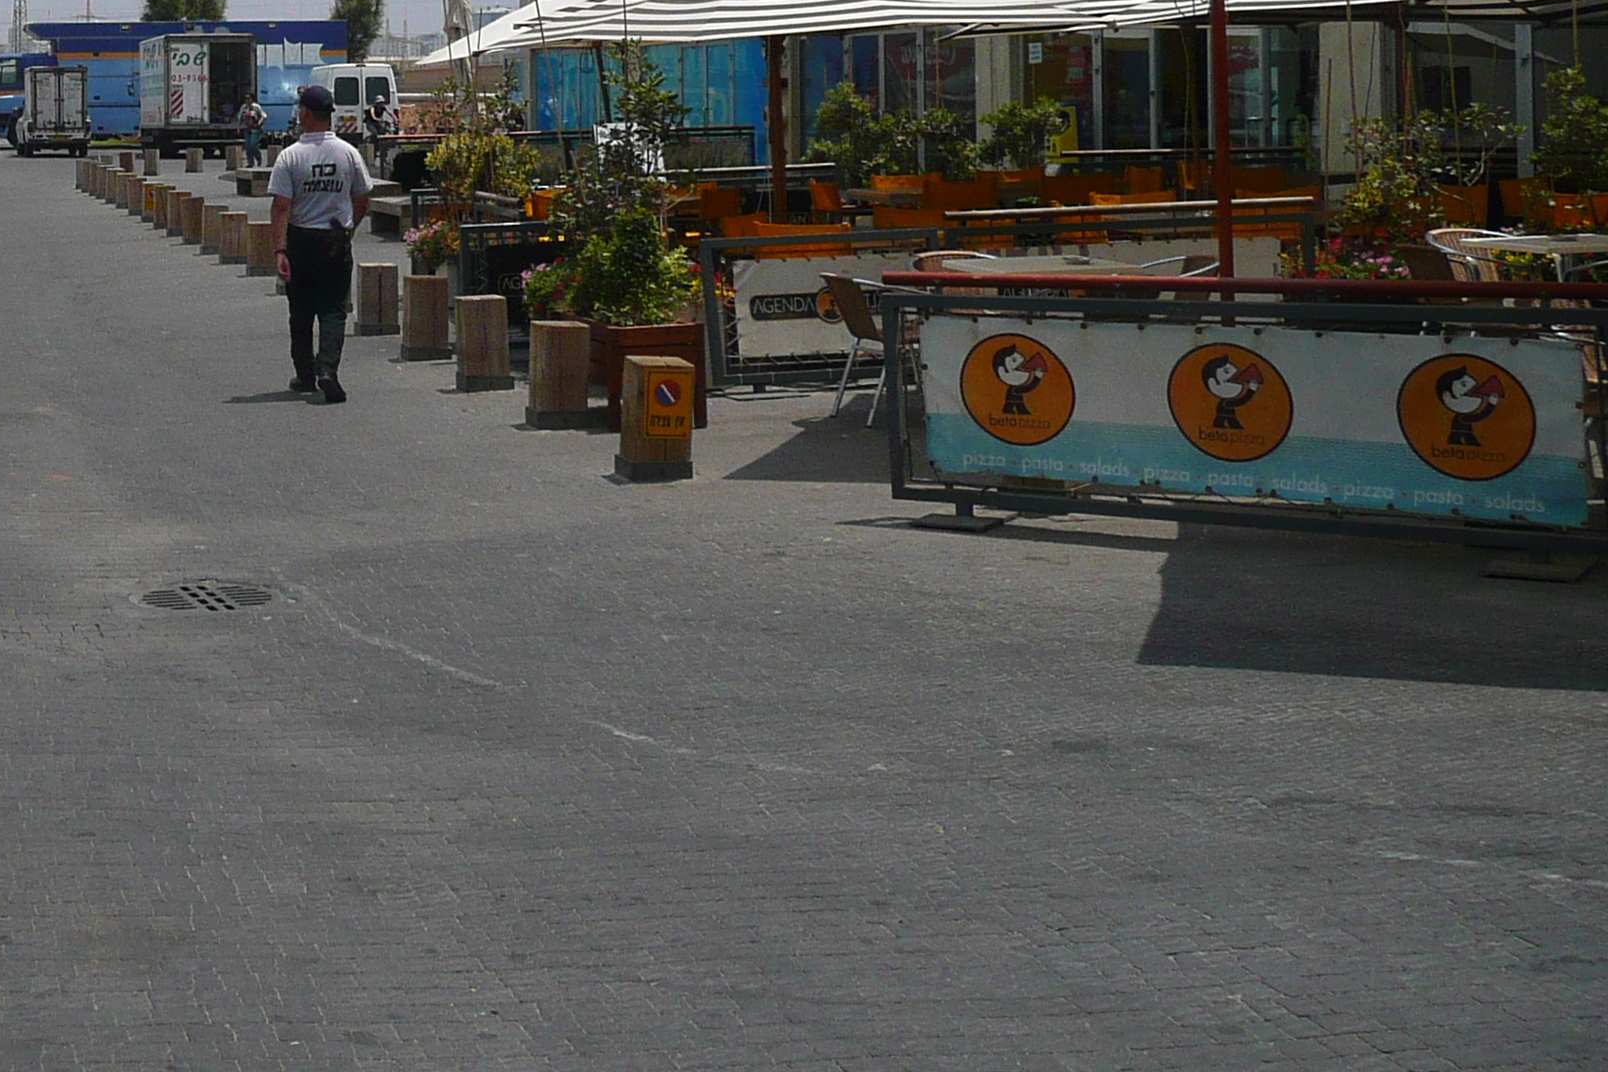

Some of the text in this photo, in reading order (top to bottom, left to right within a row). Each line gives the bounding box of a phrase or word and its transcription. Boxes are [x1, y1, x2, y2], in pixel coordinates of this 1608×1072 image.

[753, 296, 816, 314] AGENDA
[962, 452, 1546, 513] pizza pasta salads pizza pasta salads pizza pasta salads
